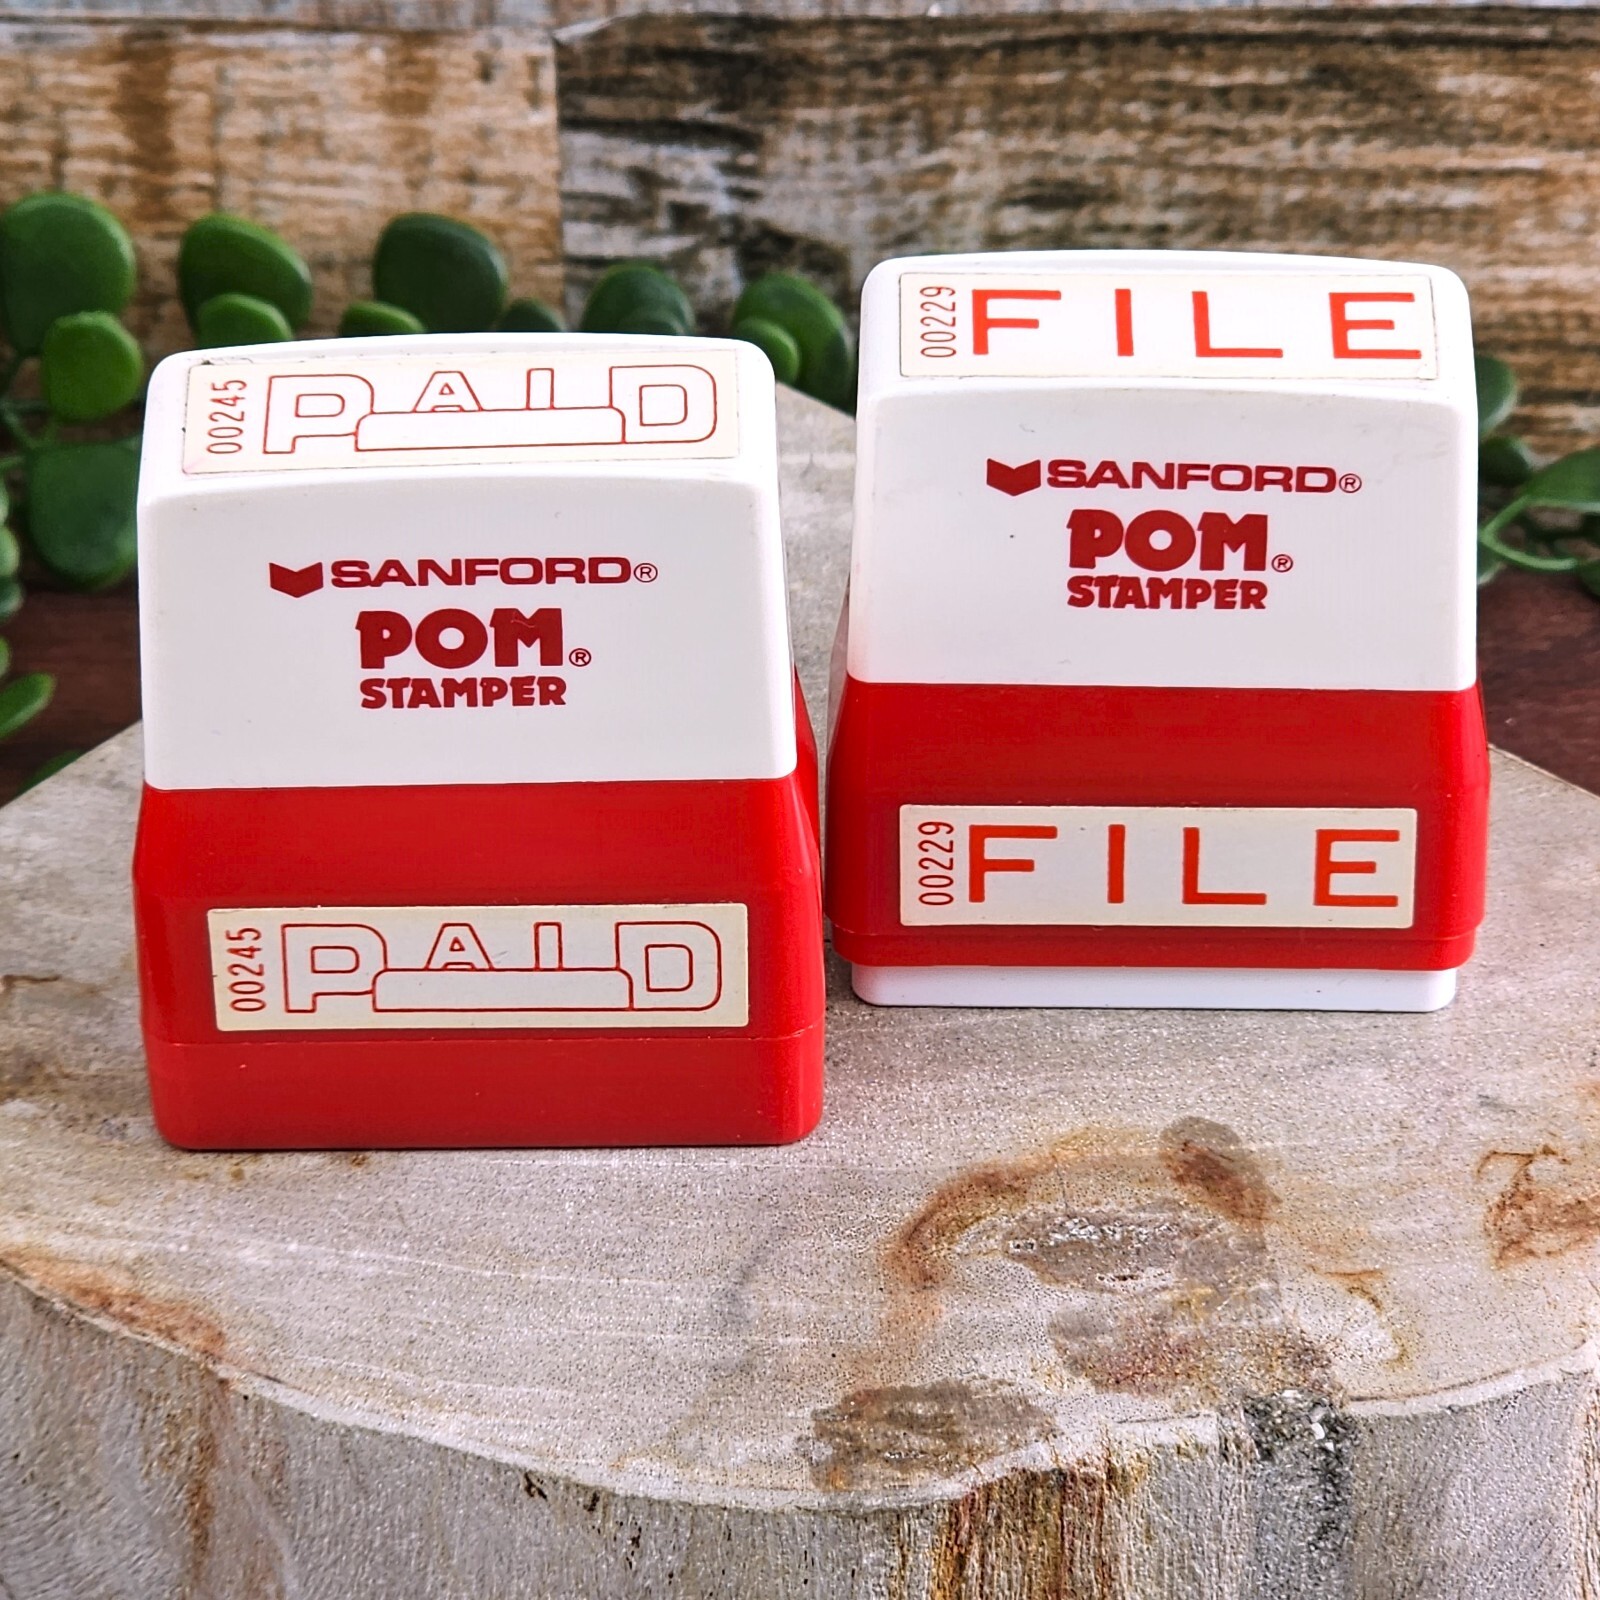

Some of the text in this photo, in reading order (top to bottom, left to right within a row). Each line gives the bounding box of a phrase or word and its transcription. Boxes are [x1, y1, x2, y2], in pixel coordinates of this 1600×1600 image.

[919, 285, 957, 359] 00229
[971, 287, 1424, 360] FILE
[206, 379, 248, 455] 00245
[262, 364, 719, 455] PAID
[1066, 574, 1269, 610] STAMPER
[360, 674, 567, 710] STAMPER
[917, 820, 955, 907] 00229
[968, 823, 1401, 907] FILE
[226, 926, 266, 1012] 00245
[280, 920, 723, 1014] PAID
